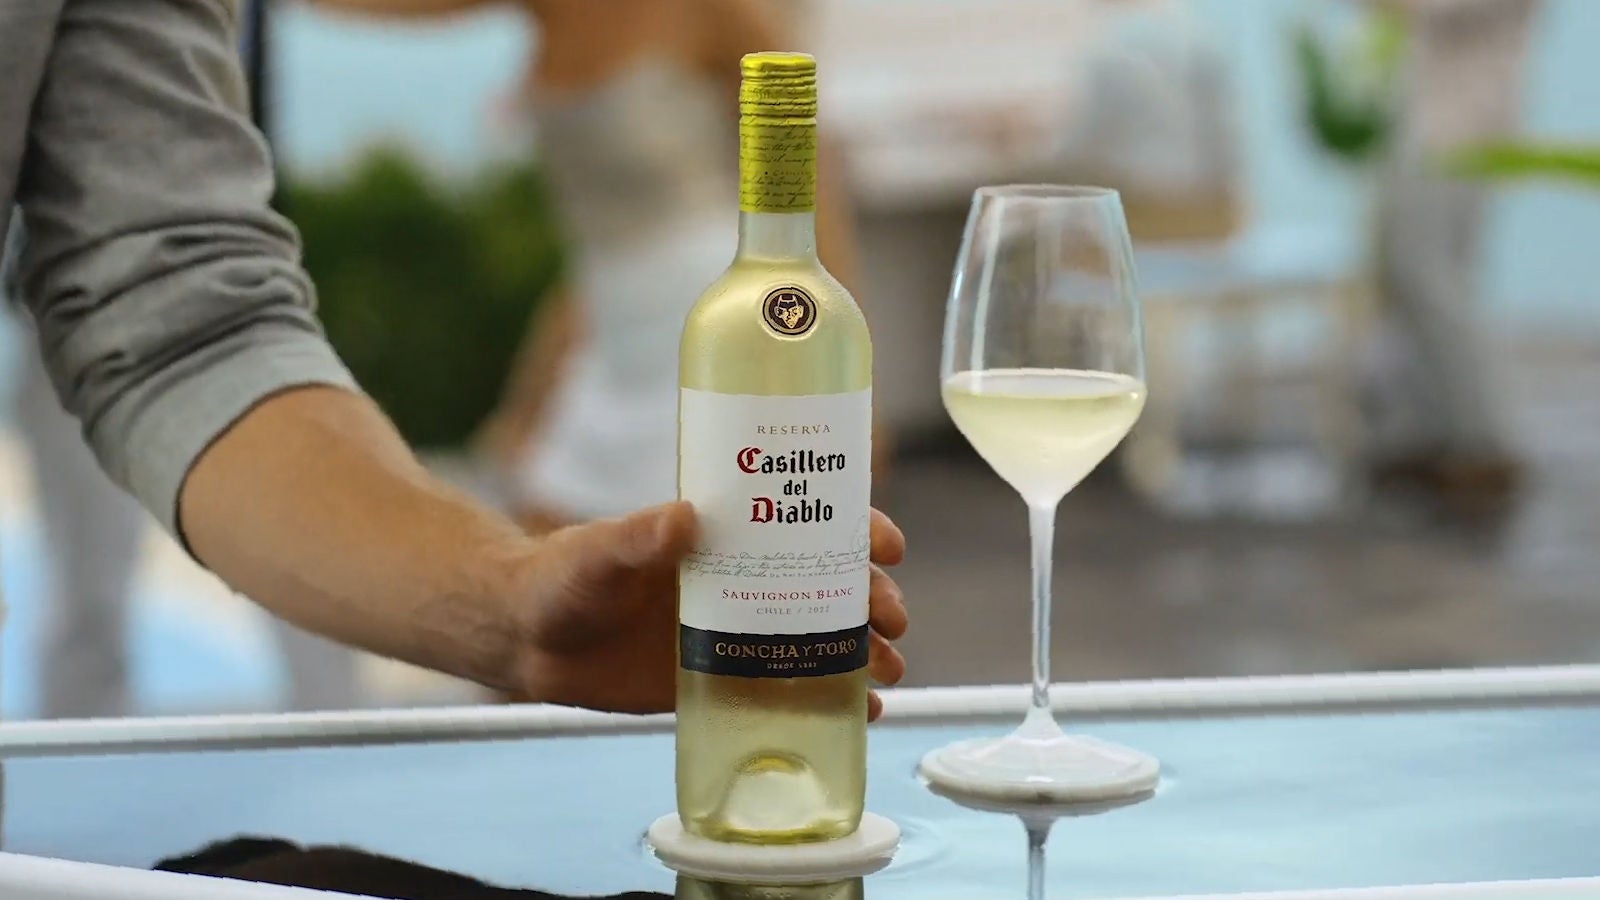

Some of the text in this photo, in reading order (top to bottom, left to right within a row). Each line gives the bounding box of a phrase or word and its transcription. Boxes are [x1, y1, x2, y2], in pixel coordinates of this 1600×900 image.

[756, 424, 832, 435] RESERVA
[736, 446, 846, 474] Casillero
[783, 479, 808, 496] del
[750, 497, 833, 524] Diablo
[721, 586, 854, 601] SAUVIGNON BLANC
[756, 607, 793, 615] CHILE
[715, 639, 857, 659] CONCHA Y TORO
